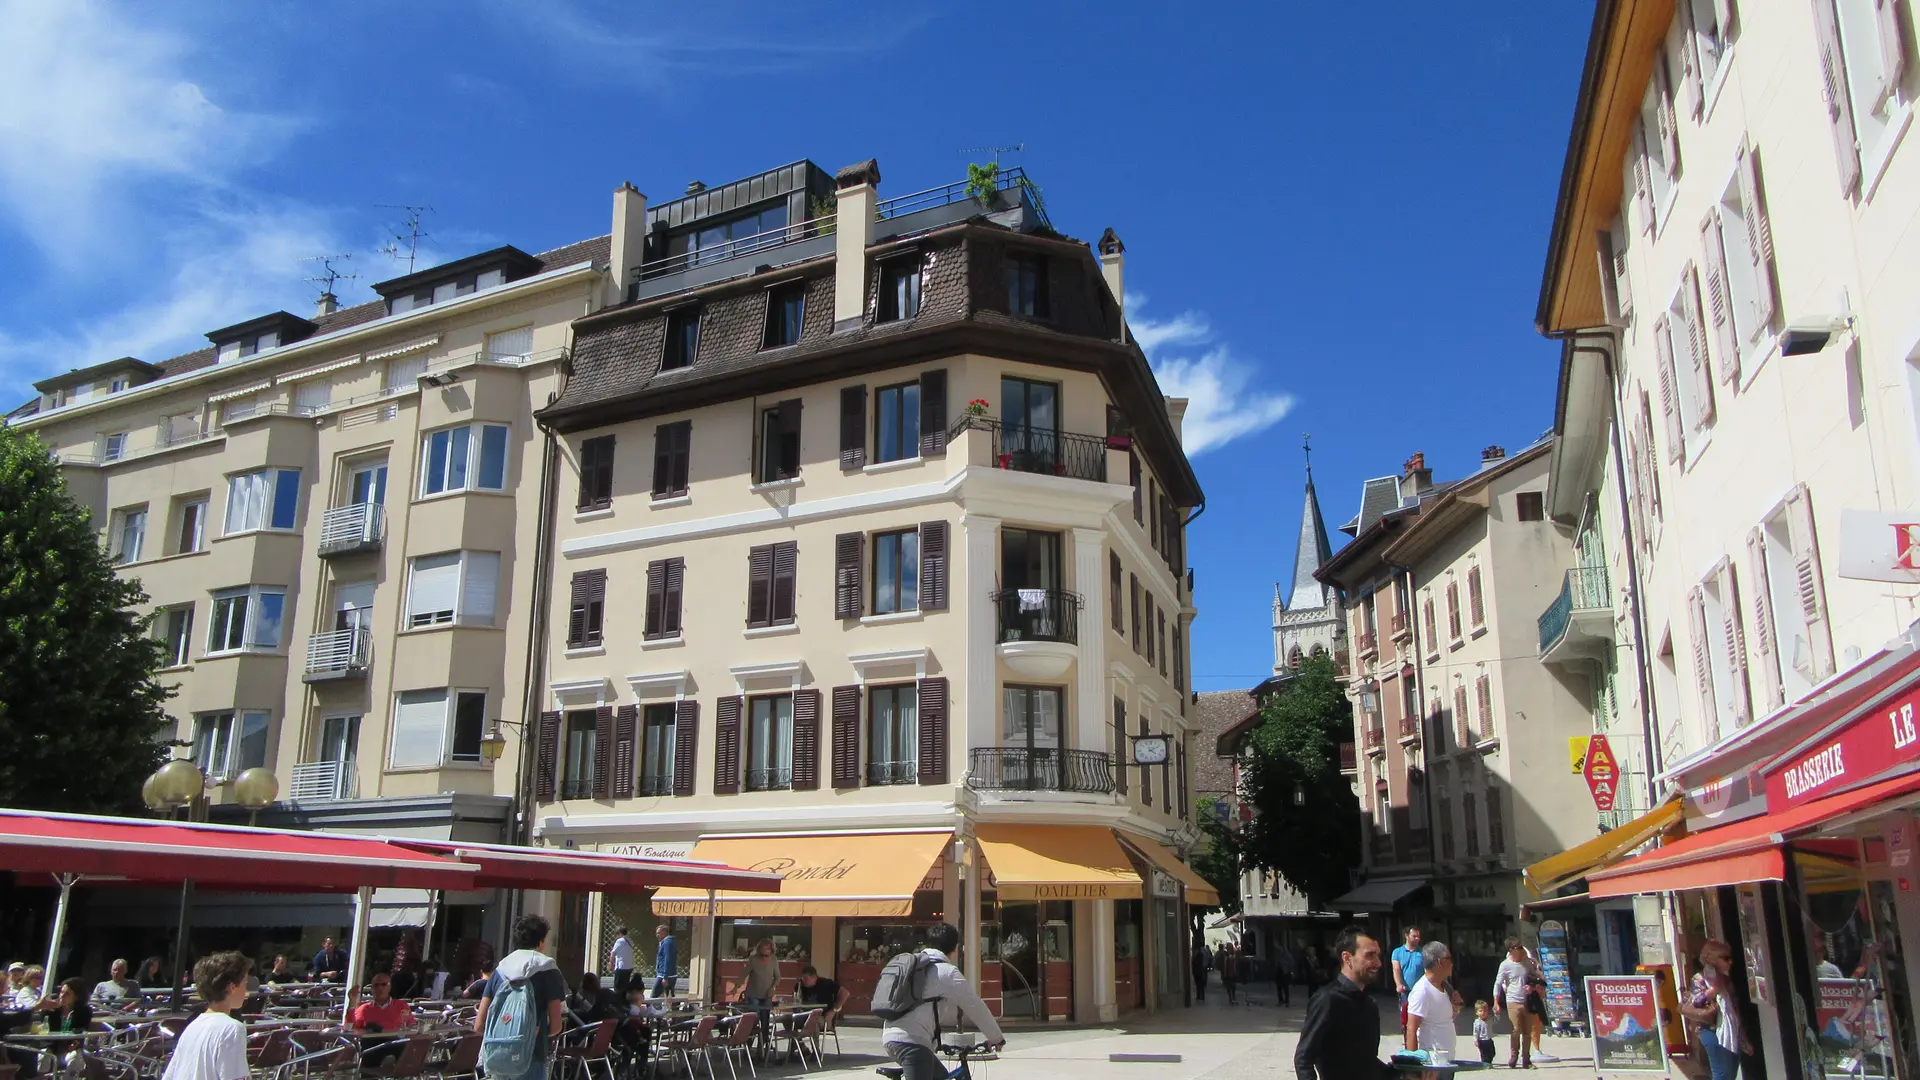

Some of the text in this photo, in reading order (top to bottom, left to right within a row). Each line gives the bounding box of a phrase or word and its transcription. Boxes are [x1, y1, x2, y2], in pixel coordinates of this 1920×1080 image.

[1784, 703, 1917, 799] BRASSERIE LE
[1591, 738, 1612, 808] TABAC
[644, 847, 686, 858] Boutique
[1594, 983, 1647, 993] Chocolats
[1601, 994, 1643, 1004] Suisses
